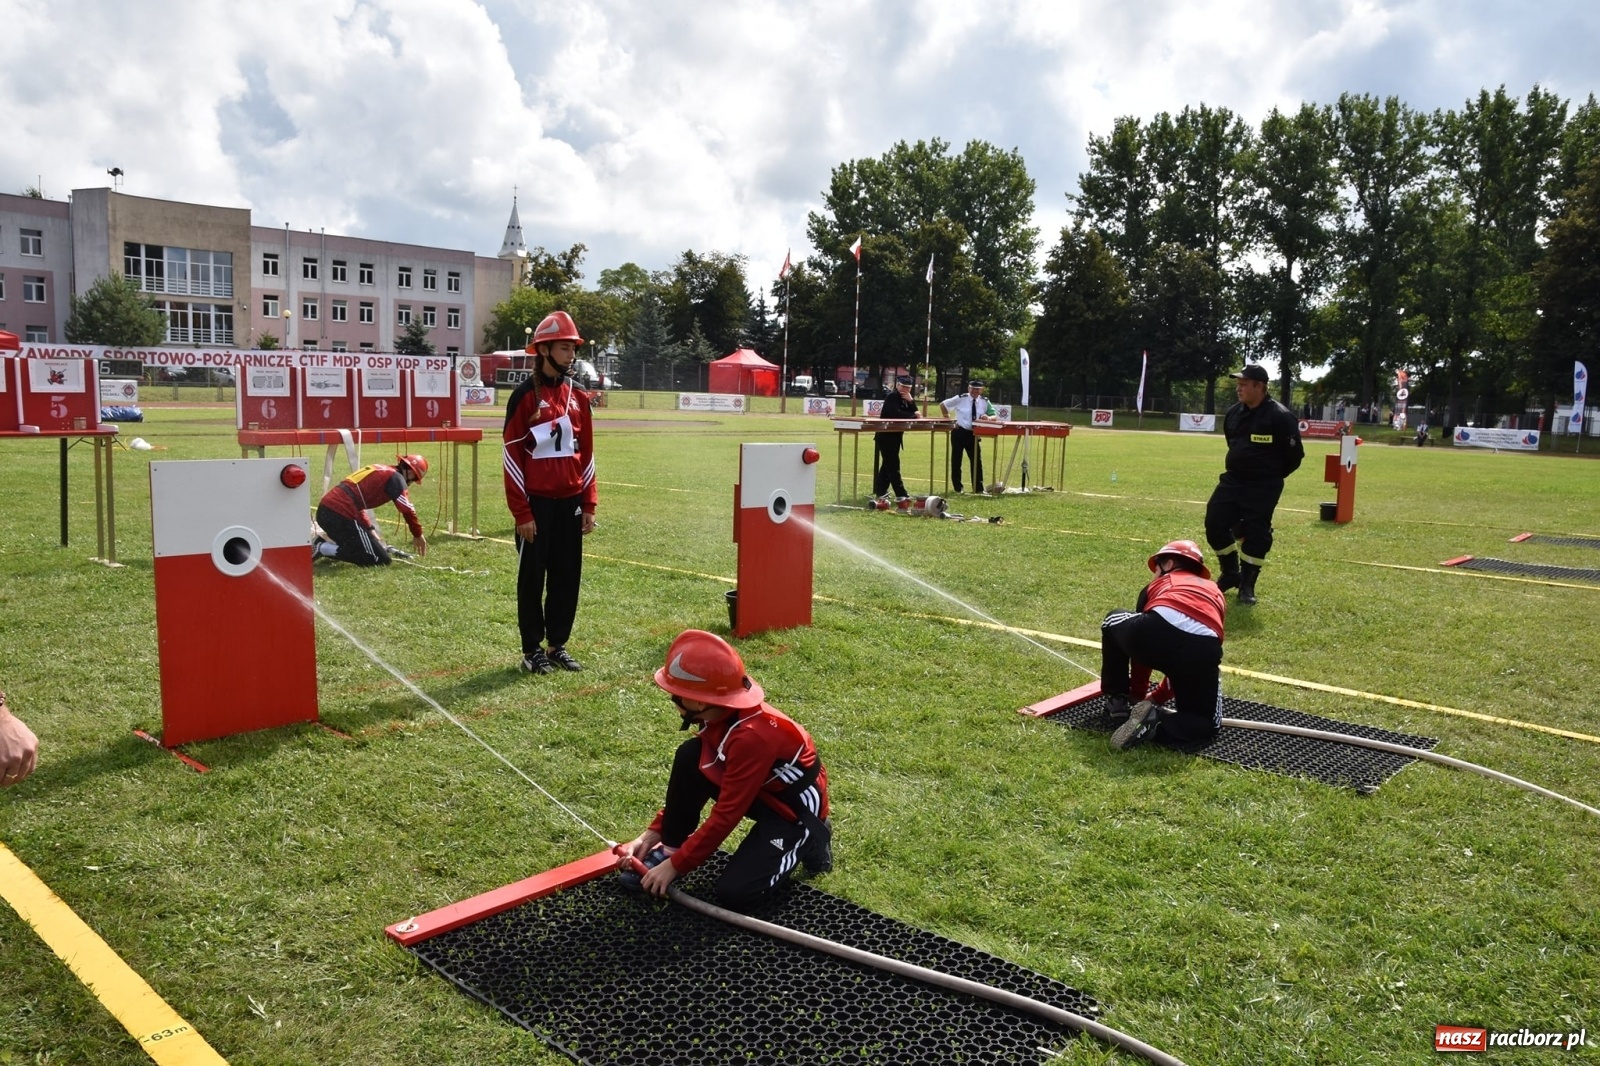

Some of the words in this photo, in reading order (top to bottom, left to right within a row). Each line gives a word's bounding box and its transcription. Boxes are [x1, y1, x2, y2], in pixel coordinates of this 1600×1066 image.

[299, 354, 328, 367] CTIF
[333, 356, 361, 368] MDP
[367, 356, 392, 369] OSP
[396, 358, 420, 370] KDP
[426, 359, 448, 370] PSP
[50, 395, 68, 418] 5
[261, 399, 277, 419] 6
[320, 399, 333, 419] 7
[374, 399, 388, 419] 8
[426, 399, 440, 419] 9
[549, 422, 563, 452] 1
